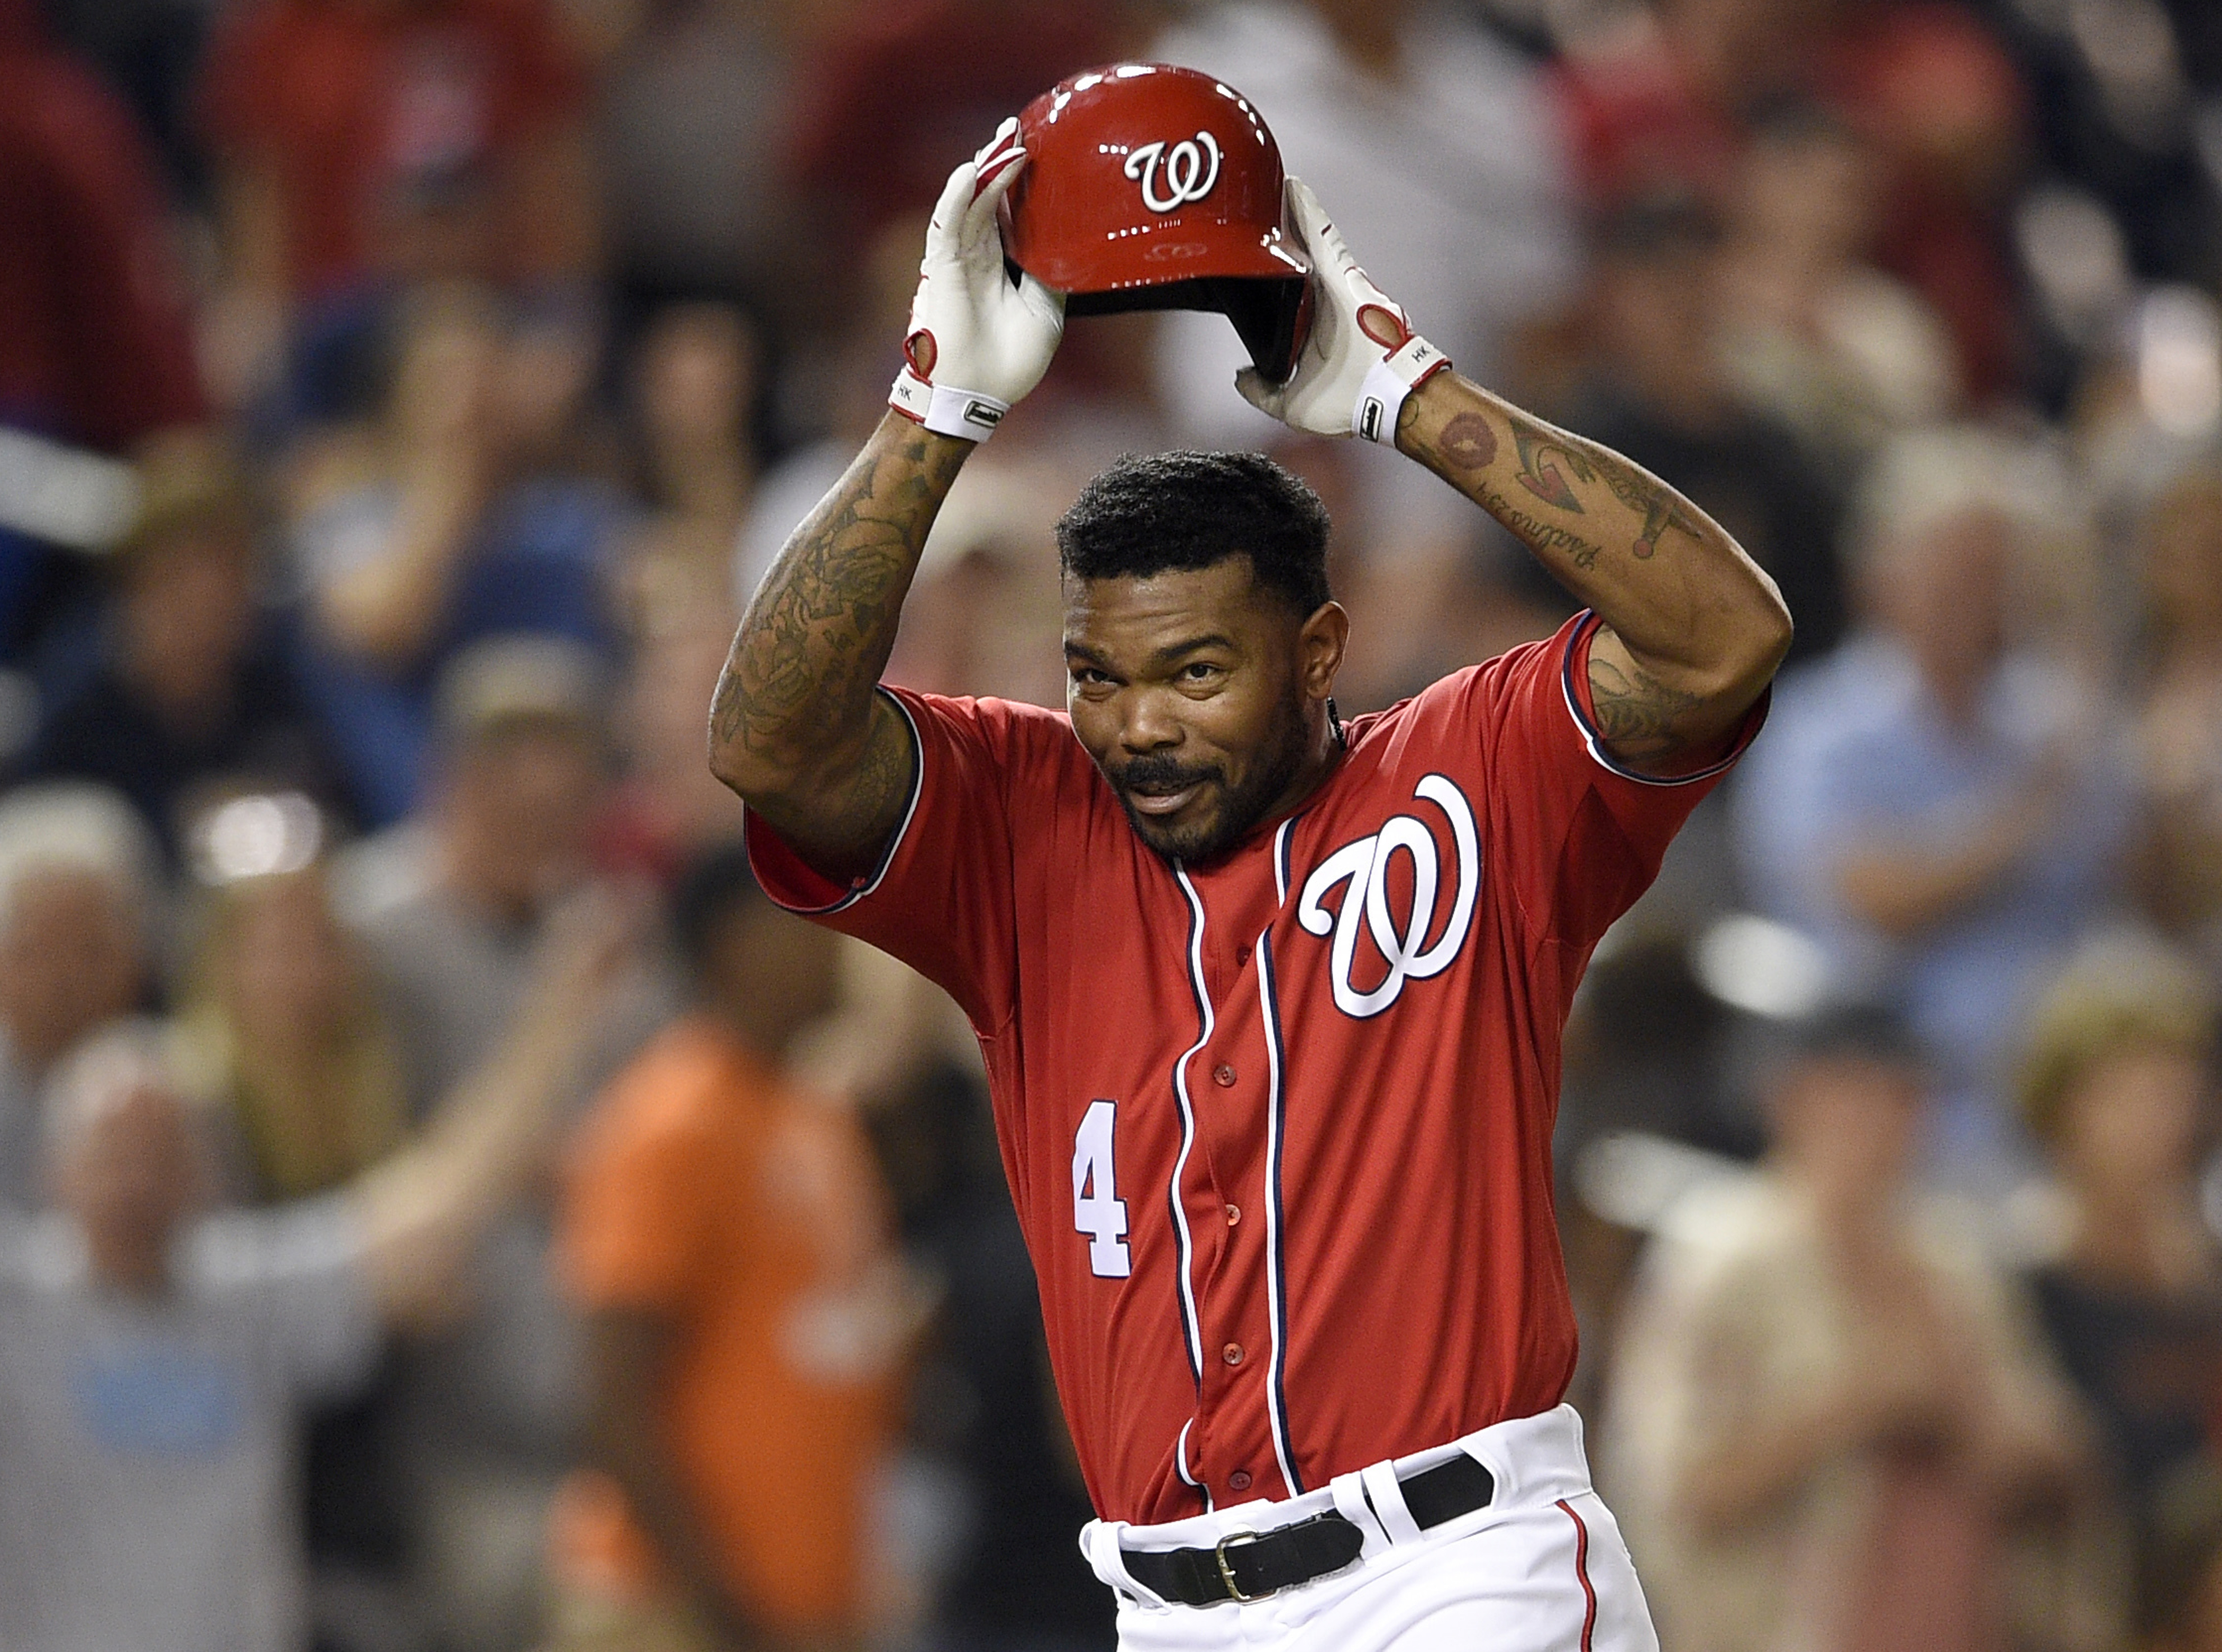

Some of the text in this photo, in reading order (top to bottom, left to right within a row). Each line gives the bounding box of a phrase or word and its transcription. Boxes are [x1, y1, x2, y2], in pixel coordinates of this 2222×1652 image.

[1124, 131, 1219, 213] W
[1411, 346, 1430, 362] HK
[1297, 772, 1481, 1020] W
[1072, 1099, 1132, 1279] 4
